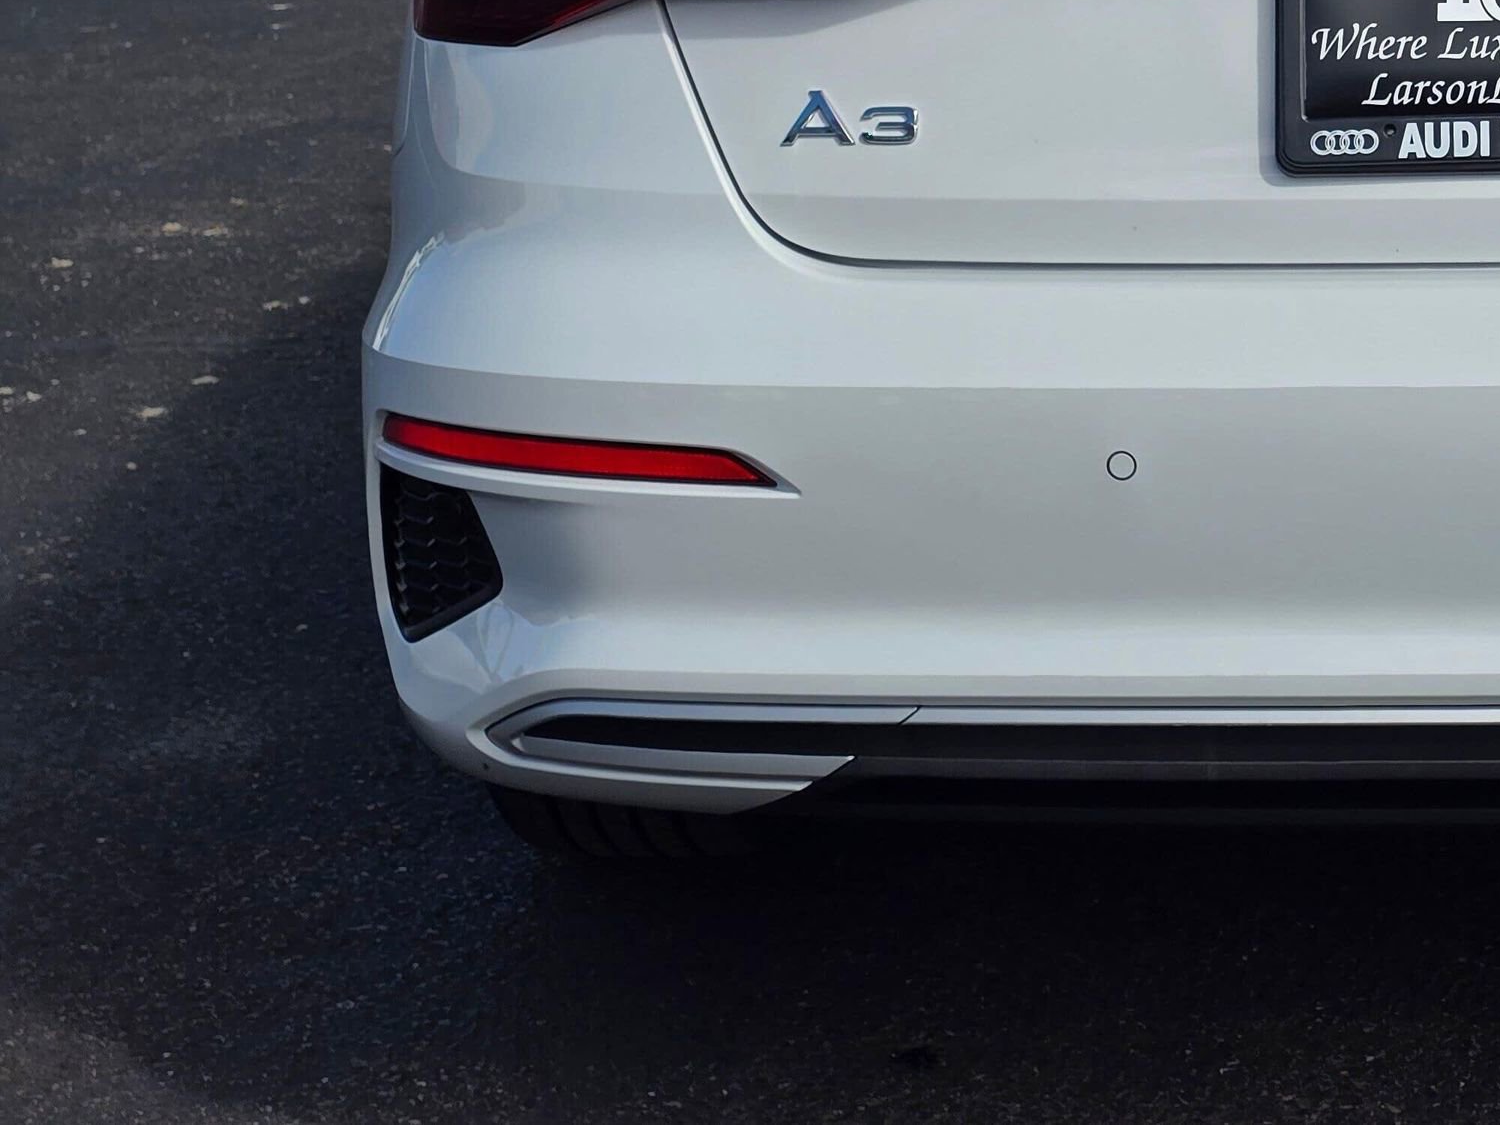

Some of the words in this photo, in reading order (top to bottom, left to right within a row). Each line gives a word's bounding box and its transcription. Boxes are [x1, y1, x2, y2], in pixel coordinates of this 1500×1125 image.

[1311, 22, 1428, 62] Where
[780, 90, 919, 147] A3
[1398, 120, 1491, 160] AUDI
